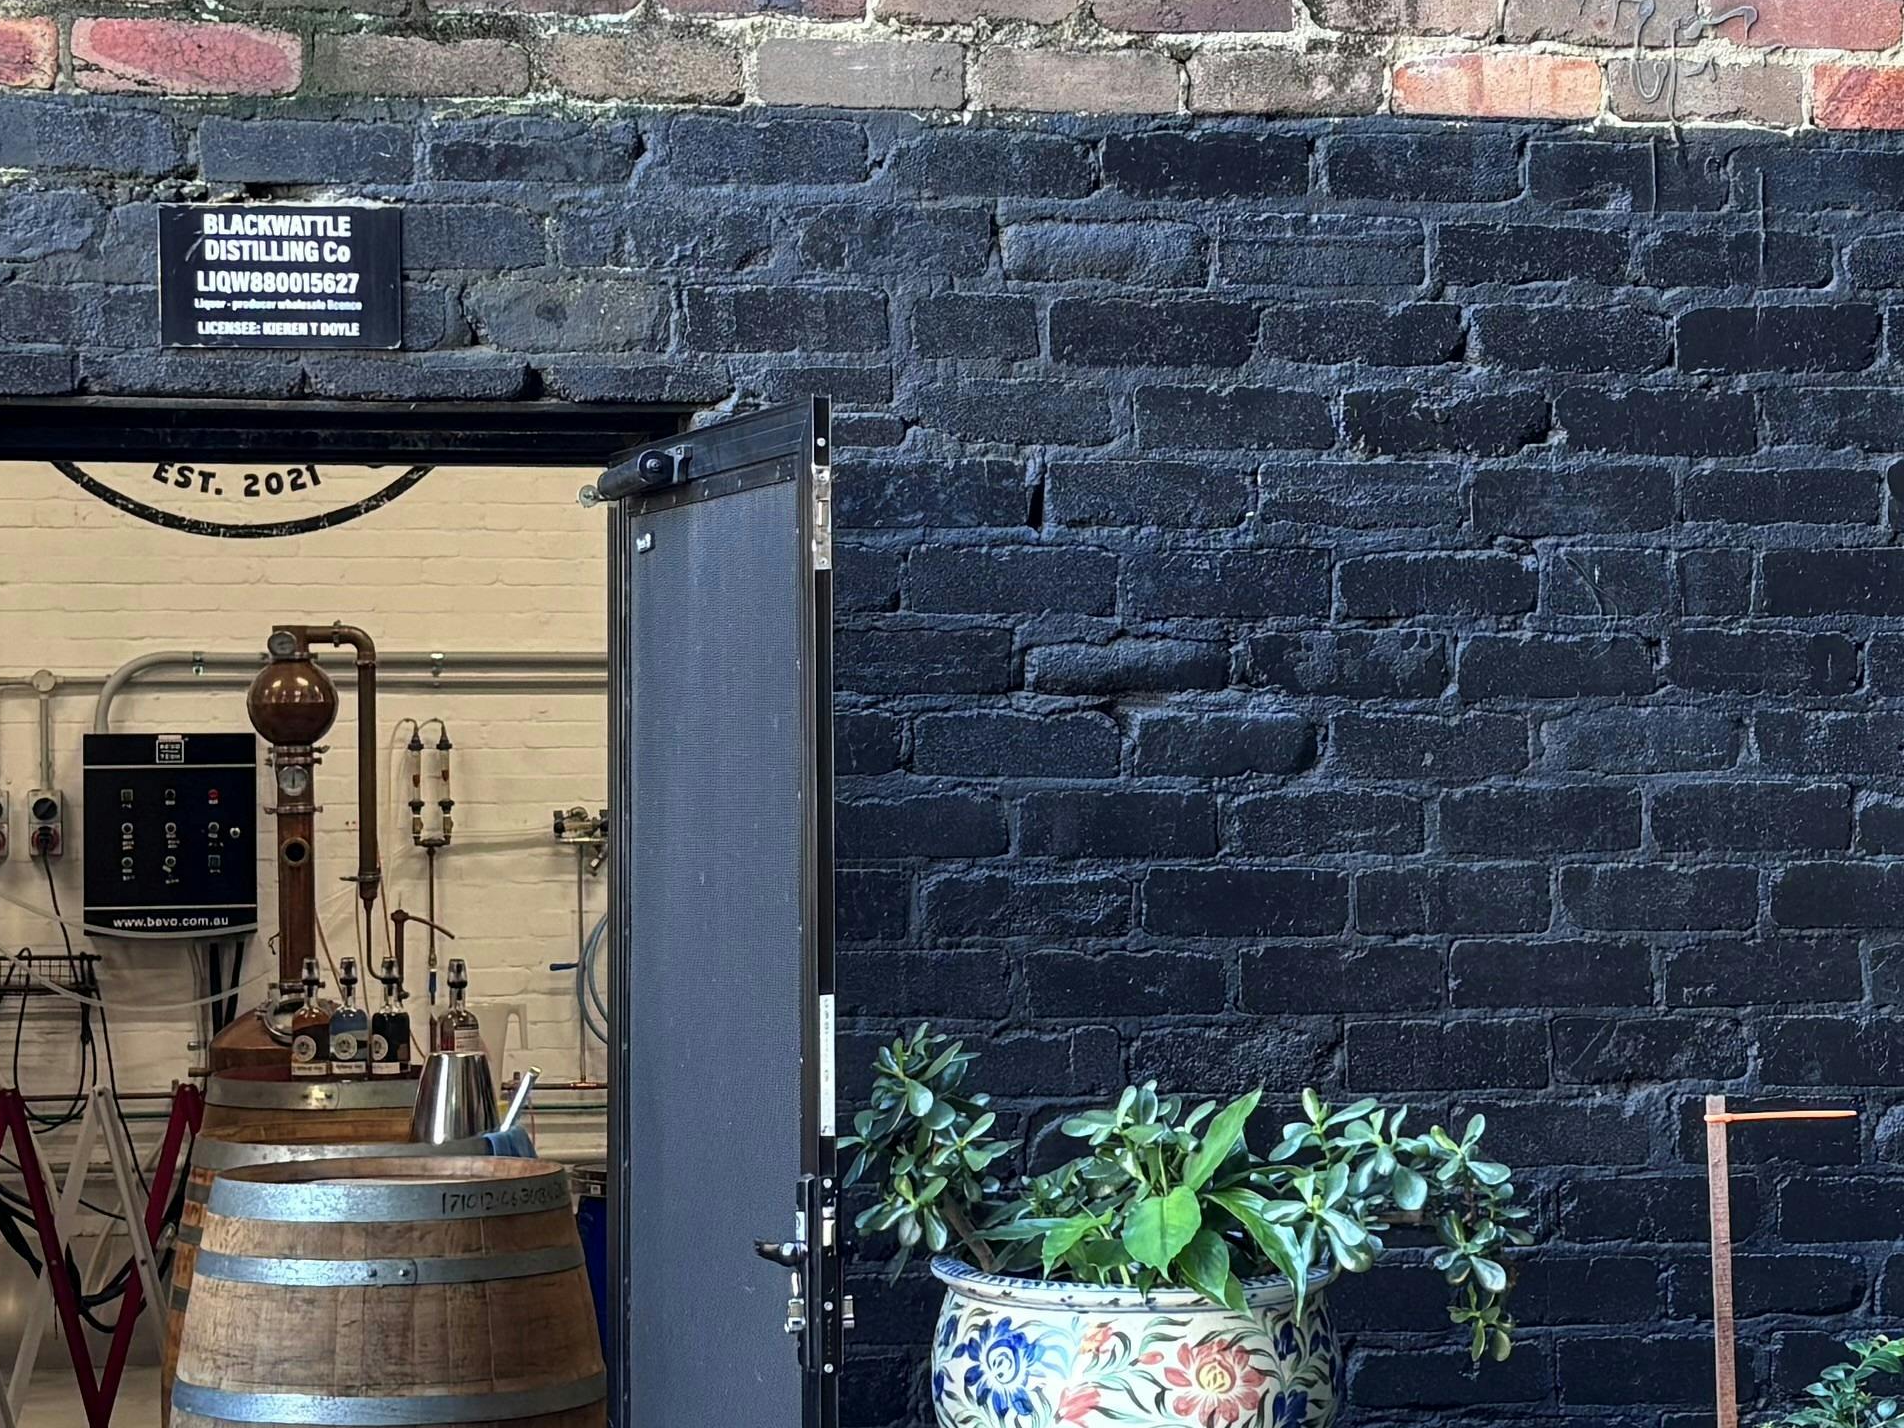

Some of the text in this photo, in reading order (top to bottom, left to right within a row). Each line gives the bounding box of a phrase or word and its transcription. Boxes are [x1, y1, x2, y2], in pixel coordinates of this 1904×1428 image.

[203, 214, 352, 237] BLACKWATTLE
[204, 240, 351, 263] DISTILLING Co
[197, 270, 359, 294] LIQW880015627
[194, 298, 227, 311] Liquor
[232, 298, 276, 311] producer
[277, 299, 326, 310] wholesale
[197, 321, 261, 335] LICENSEE:
[262, 322, 308, 335] KIEREN
[320, 323, 360, 336] DOYLE
[152, 461, 322, 497] EST. 2021
[113, 917, 229, 927] www.bevo.com.au
